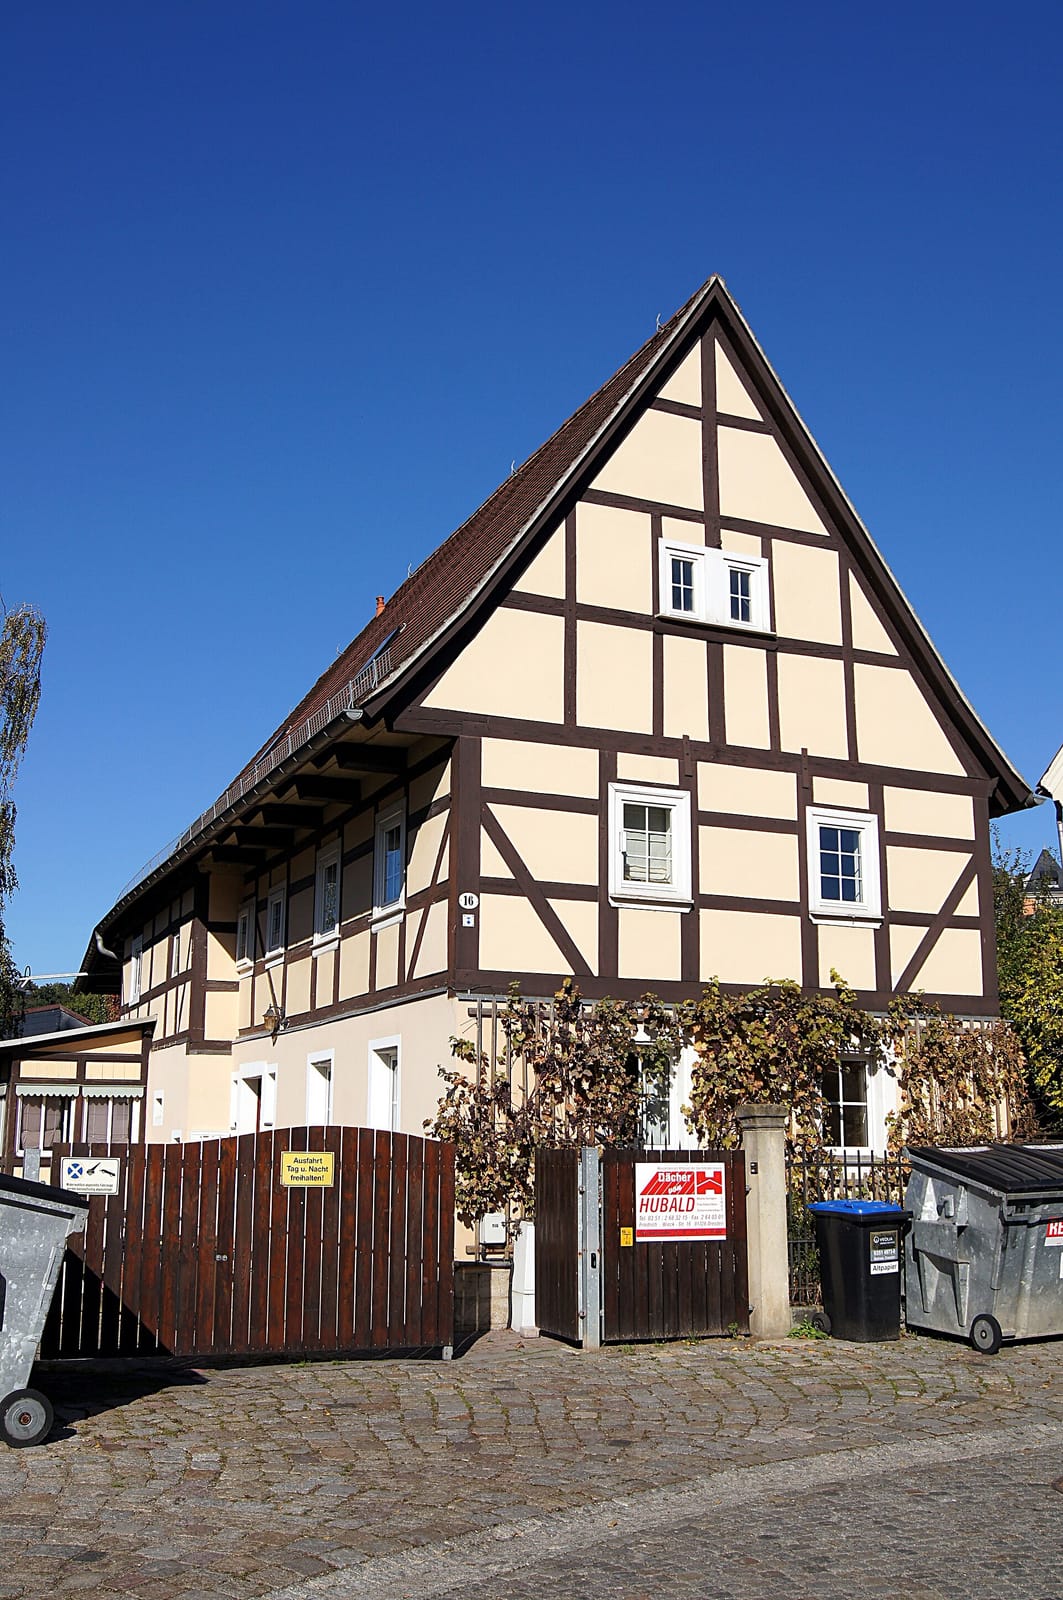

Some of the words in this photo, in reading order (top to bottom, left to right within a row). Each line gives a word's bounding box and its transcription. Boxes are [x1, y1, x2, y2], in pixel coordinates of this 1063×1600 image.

[464, 895, 474, 906] 16
[287, 1165, 299, 1173] Tag
[658, 1171, 691, 1182] Dächer
[639, 1197, 695, 1212] HUBALD
[873, 1264, 897, 1272] Altpapier
